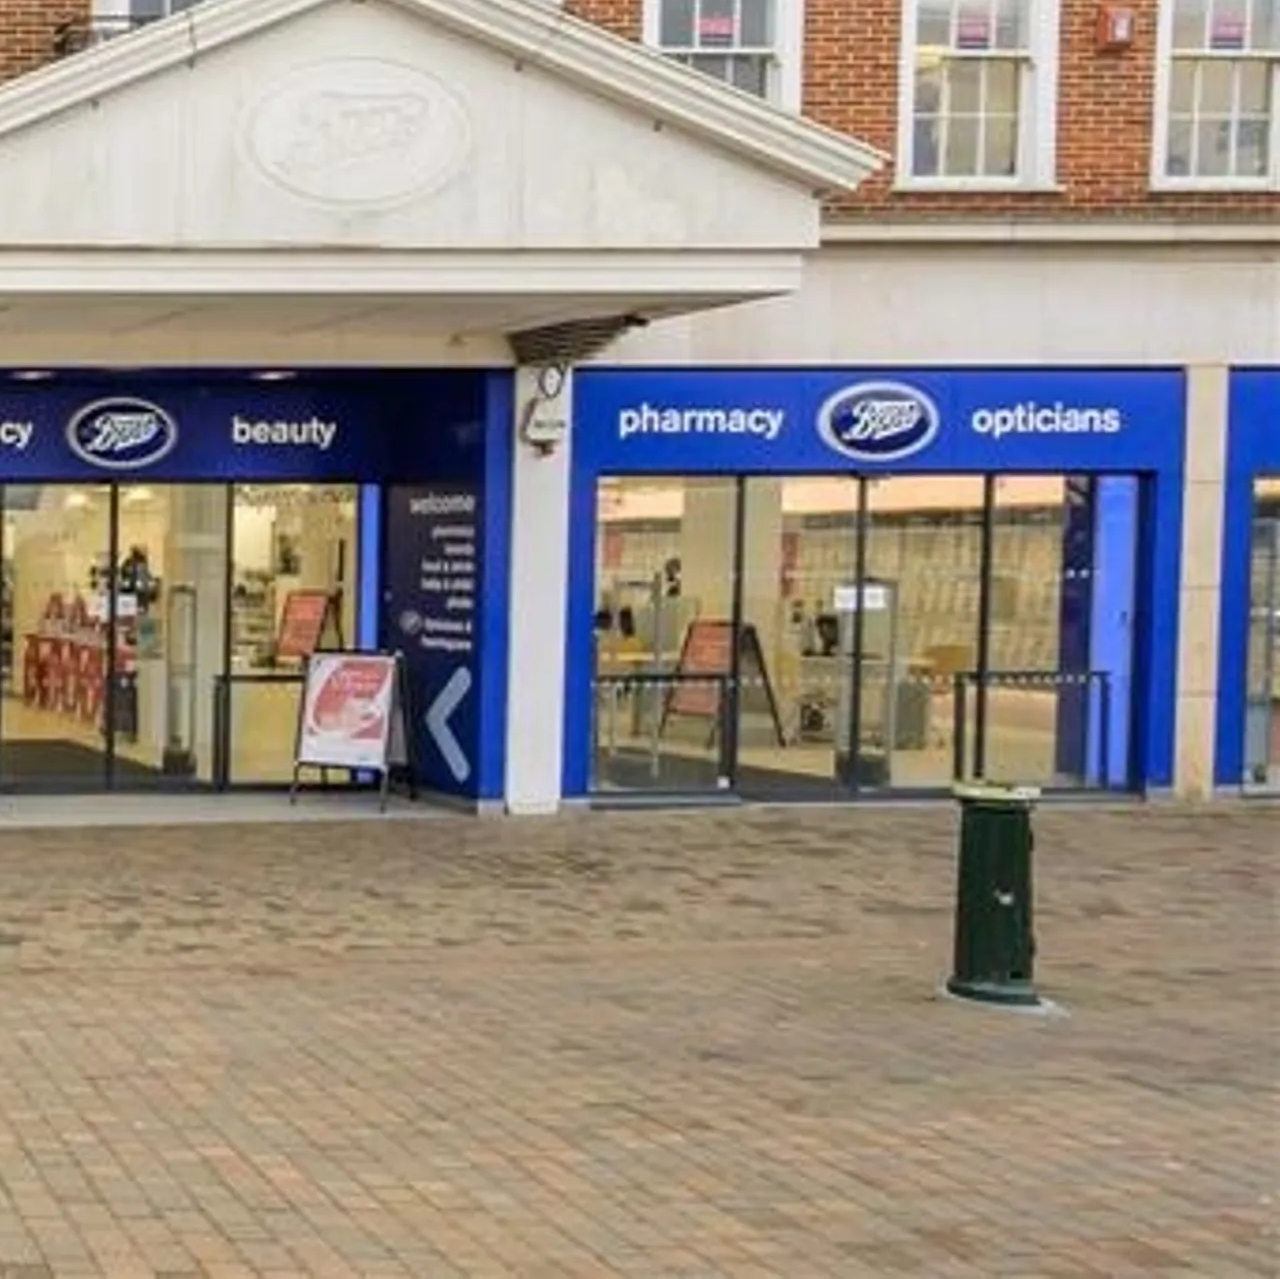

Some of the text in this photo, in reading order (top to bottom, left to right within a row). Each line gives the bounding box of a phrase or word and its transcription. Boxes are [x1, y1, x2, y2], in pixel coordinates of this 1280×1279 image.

[233, 416, 336, 449] beauty
[619, 403, 783, 440] pharmacy
[971, 402, 1120, 440] opticians
